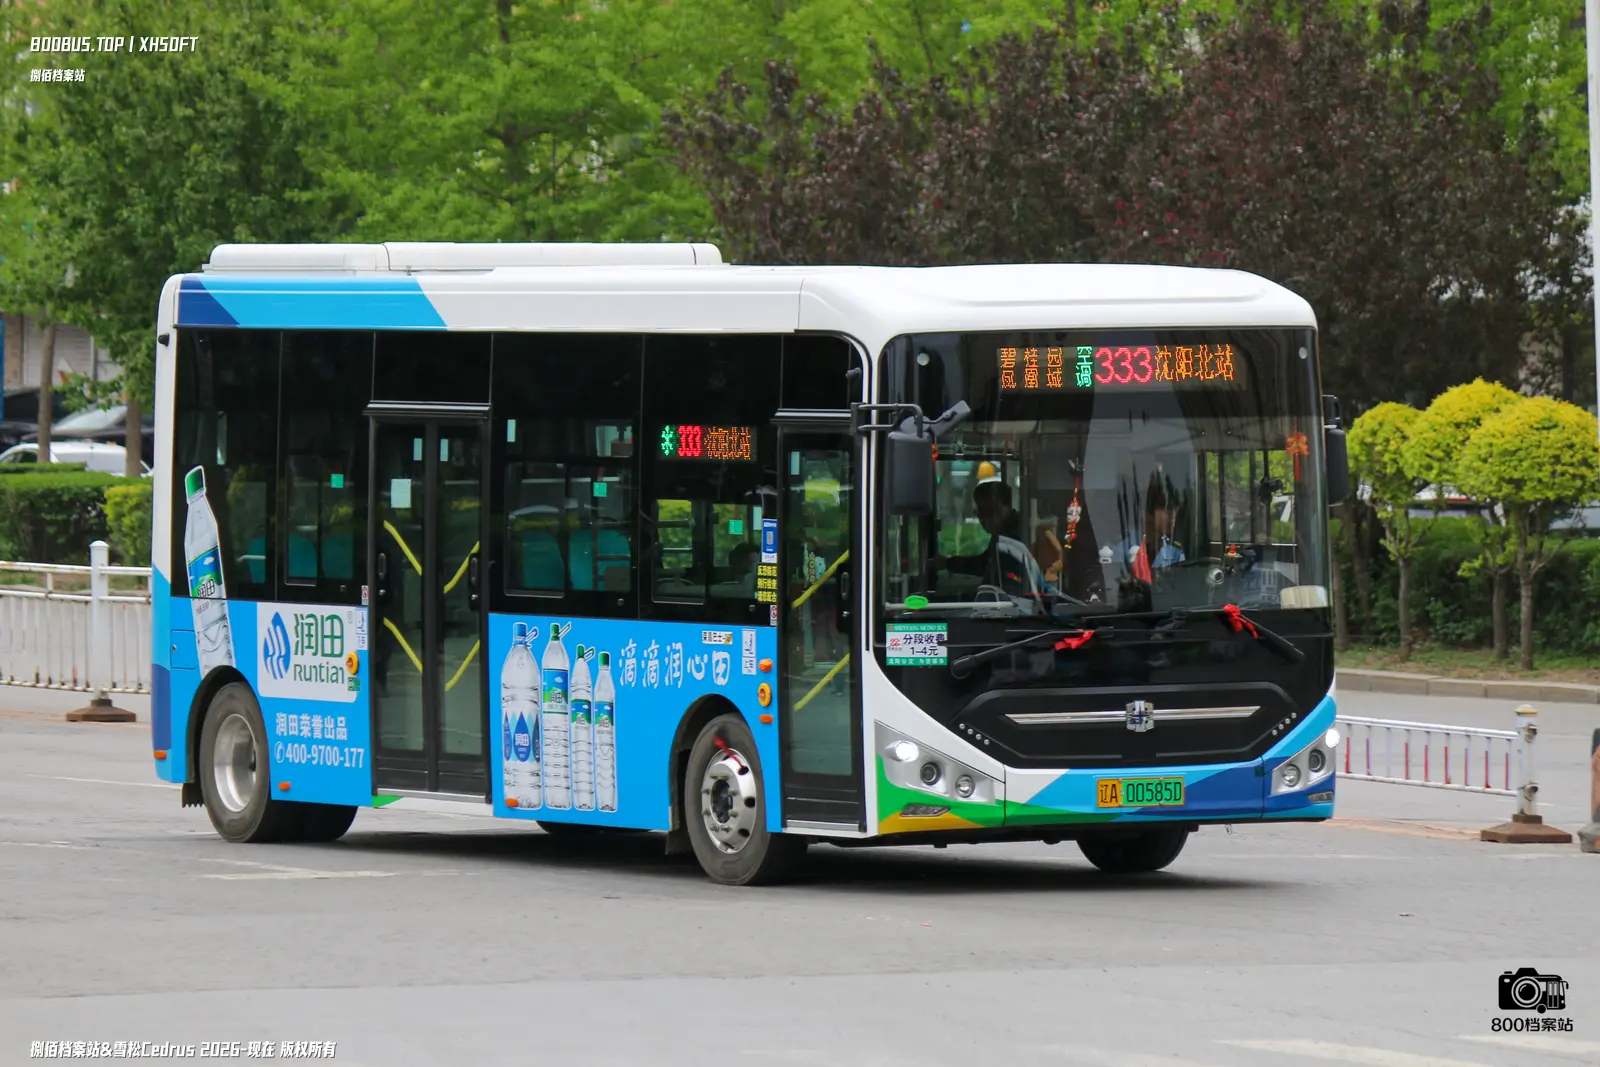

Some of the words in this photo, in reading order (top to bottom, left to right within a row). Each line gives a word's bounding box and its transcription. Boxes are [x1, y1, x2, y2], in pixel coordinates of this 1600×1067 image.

[1000, 346, 1064, 369] 碧桂园
[1075, 345, 1094, 388] 空调
[1094, 346, 1154, 384] 333
[1153, 343, 1235, 382] 沈阳北站
[292, 612, 345, 659] 润田
[902, 633, 946, 645] 分段收费
[292, 661, 345, 685] Runtian
[618, 638, 731, 689] 滴滴润心田
[275, 711, 348, 741] 润田荣誉出品
[285, 743, 365, 769] 400-9700-177
